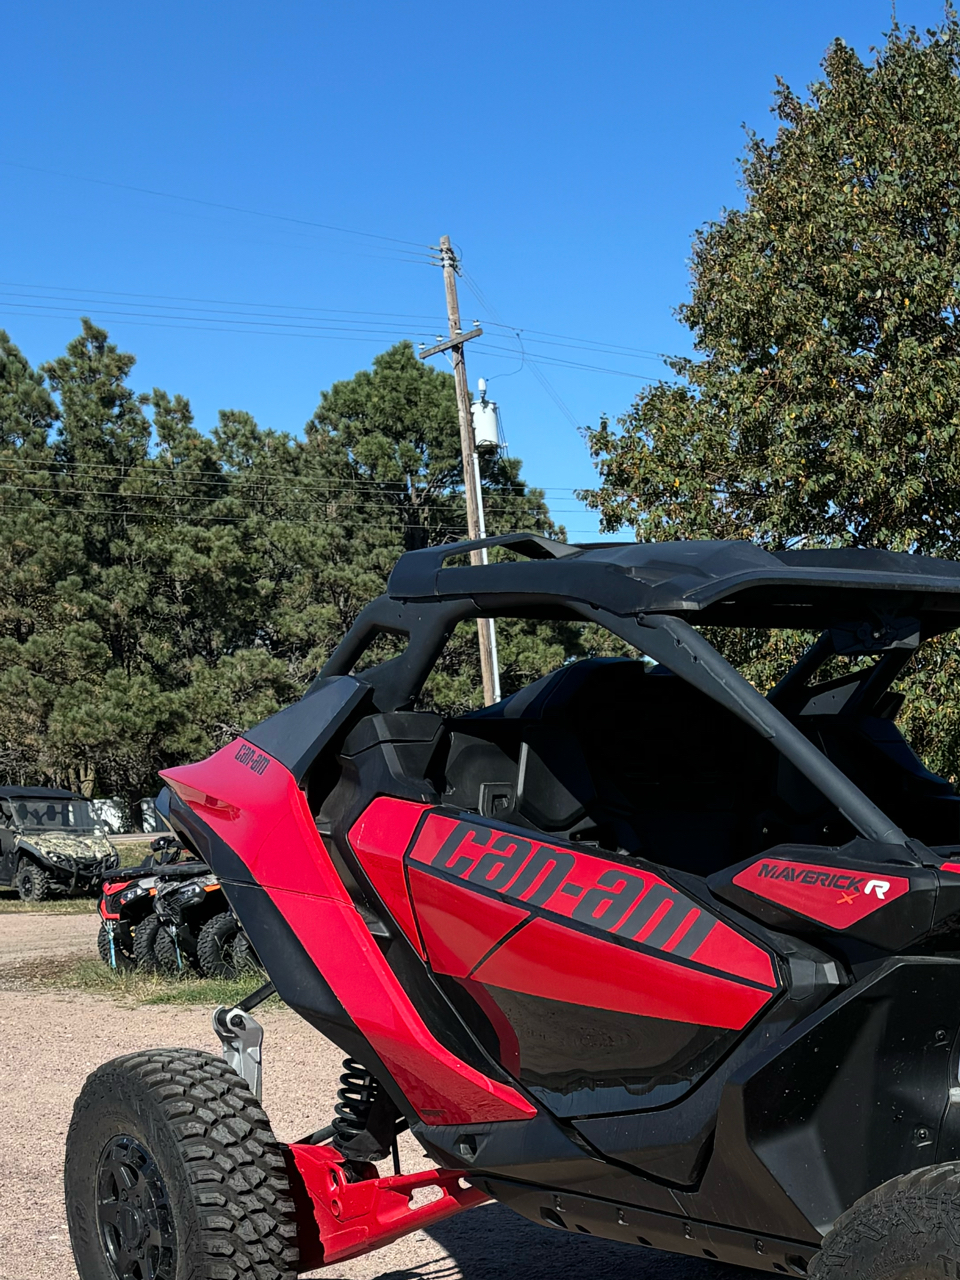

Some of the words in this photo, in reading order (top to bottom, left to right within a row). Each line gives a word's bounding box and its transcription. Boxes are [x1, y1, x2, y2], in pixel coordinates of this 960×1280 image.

[234, 743, 271, 776] can-am
[430, 821, 719, 958] can-am
[757, 863, 866, 893] MAVERICK
[864, 879, 890, 900] R
